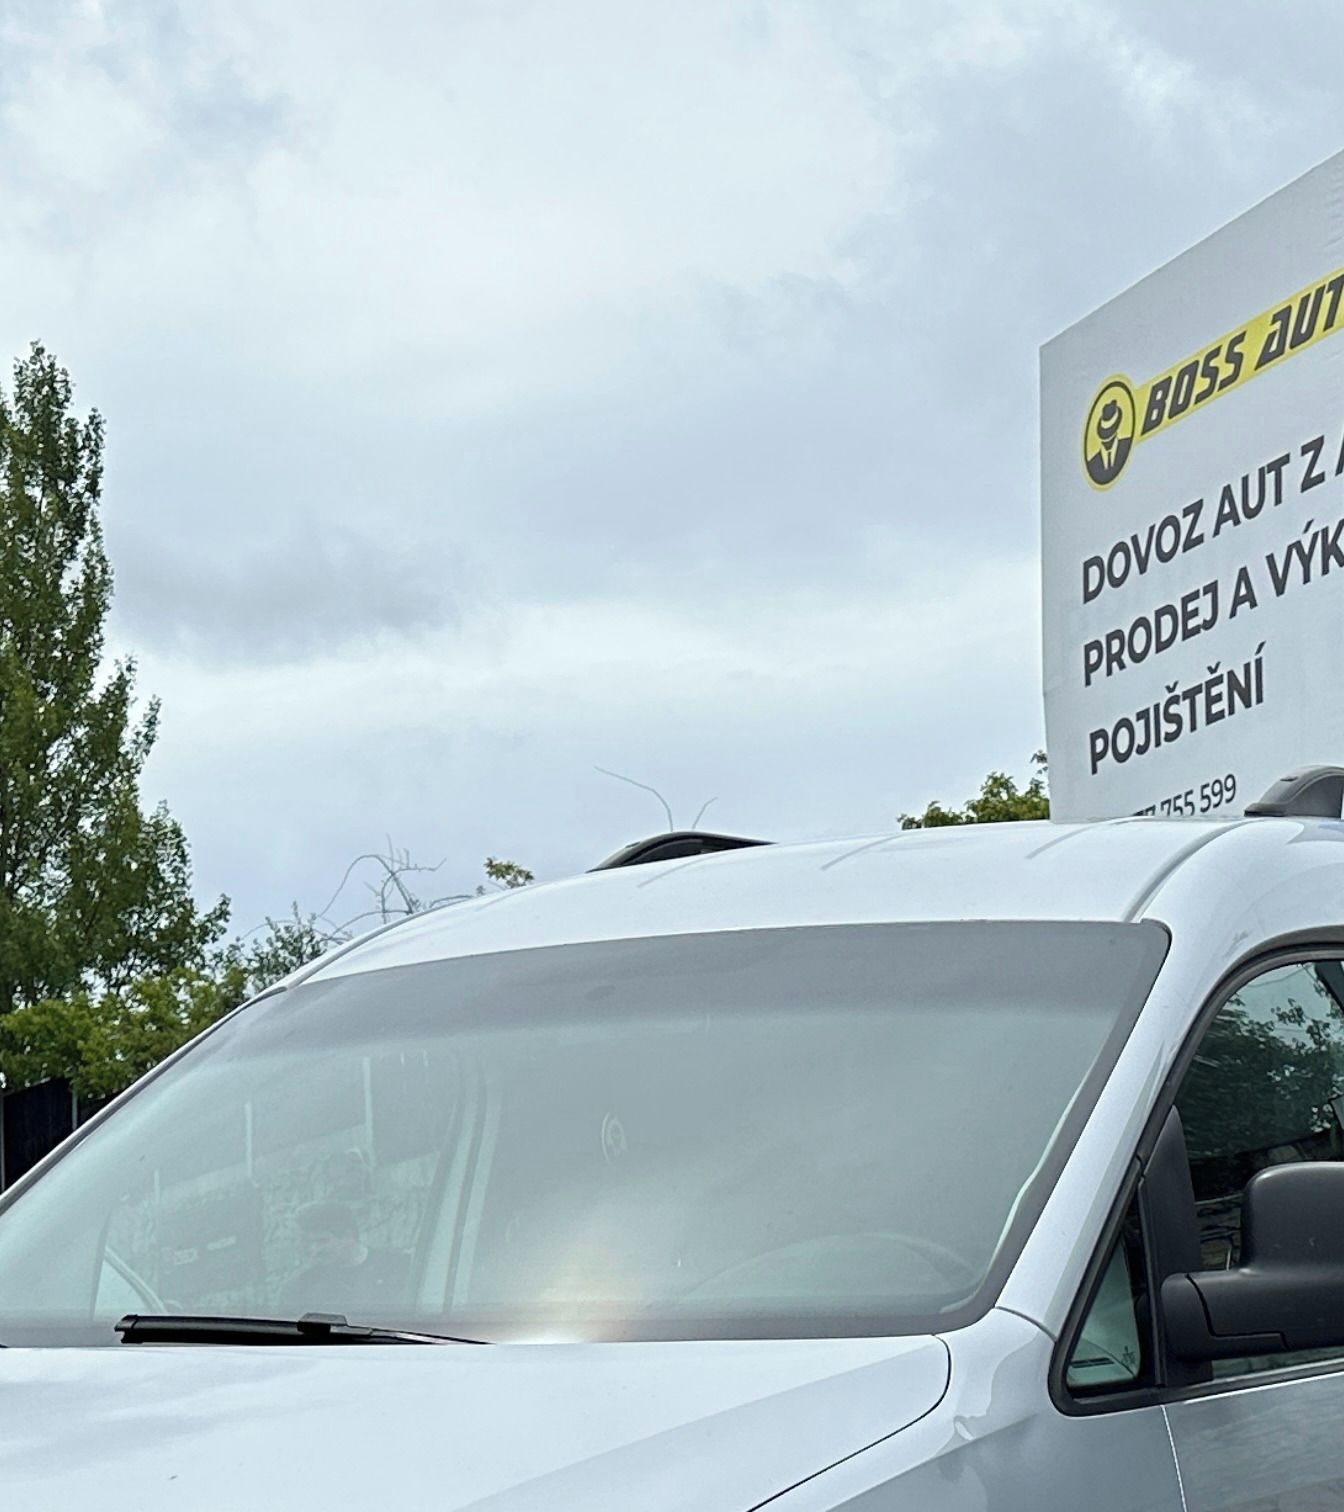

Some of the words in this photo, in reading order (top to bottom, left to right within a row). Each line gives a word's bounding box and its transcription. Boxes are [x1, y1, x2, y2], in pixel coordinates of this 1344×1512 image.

[1141, 331, 1245, 435] BOSS
[1082, 498, 1204, 605] DOVOZ
[1213, 453, 1290, 538] AUT
[1298, 435, 1327, 493] Z
[1084, 580, 1220, 687] PRODEJ
[1229, 566, 1258, 618] A
[1089, 641, 1266, 775] POJIŠTĚNÍ
[1199, 774, 1236, 813] 599
